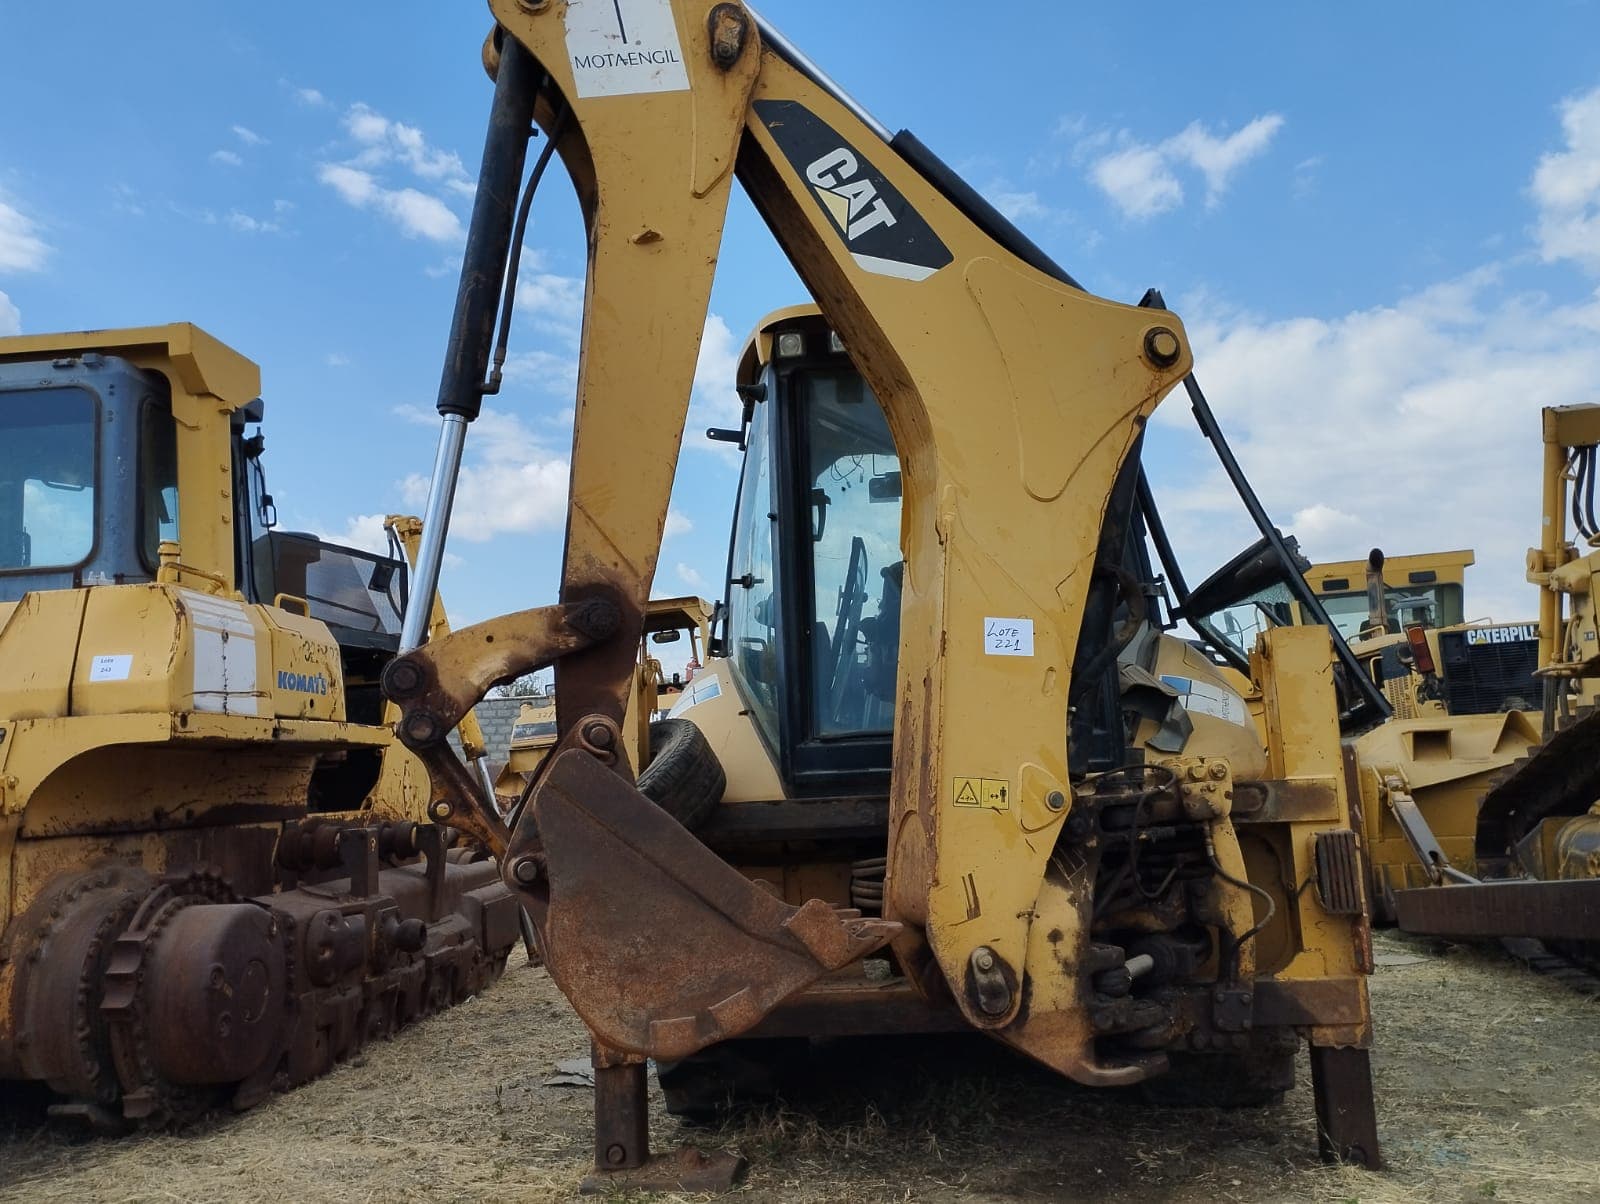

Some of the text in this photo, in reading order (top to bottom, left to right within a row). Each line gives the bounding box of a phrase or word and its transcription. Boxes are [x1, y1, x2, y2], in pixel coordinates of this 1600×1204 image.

[806, 147, 898, 241] CAT
[987, 622, 1019, 637] LOTE
[1467, 625, 1541, 645] CATERPILL
[995, 639, 1022, 651] 221
